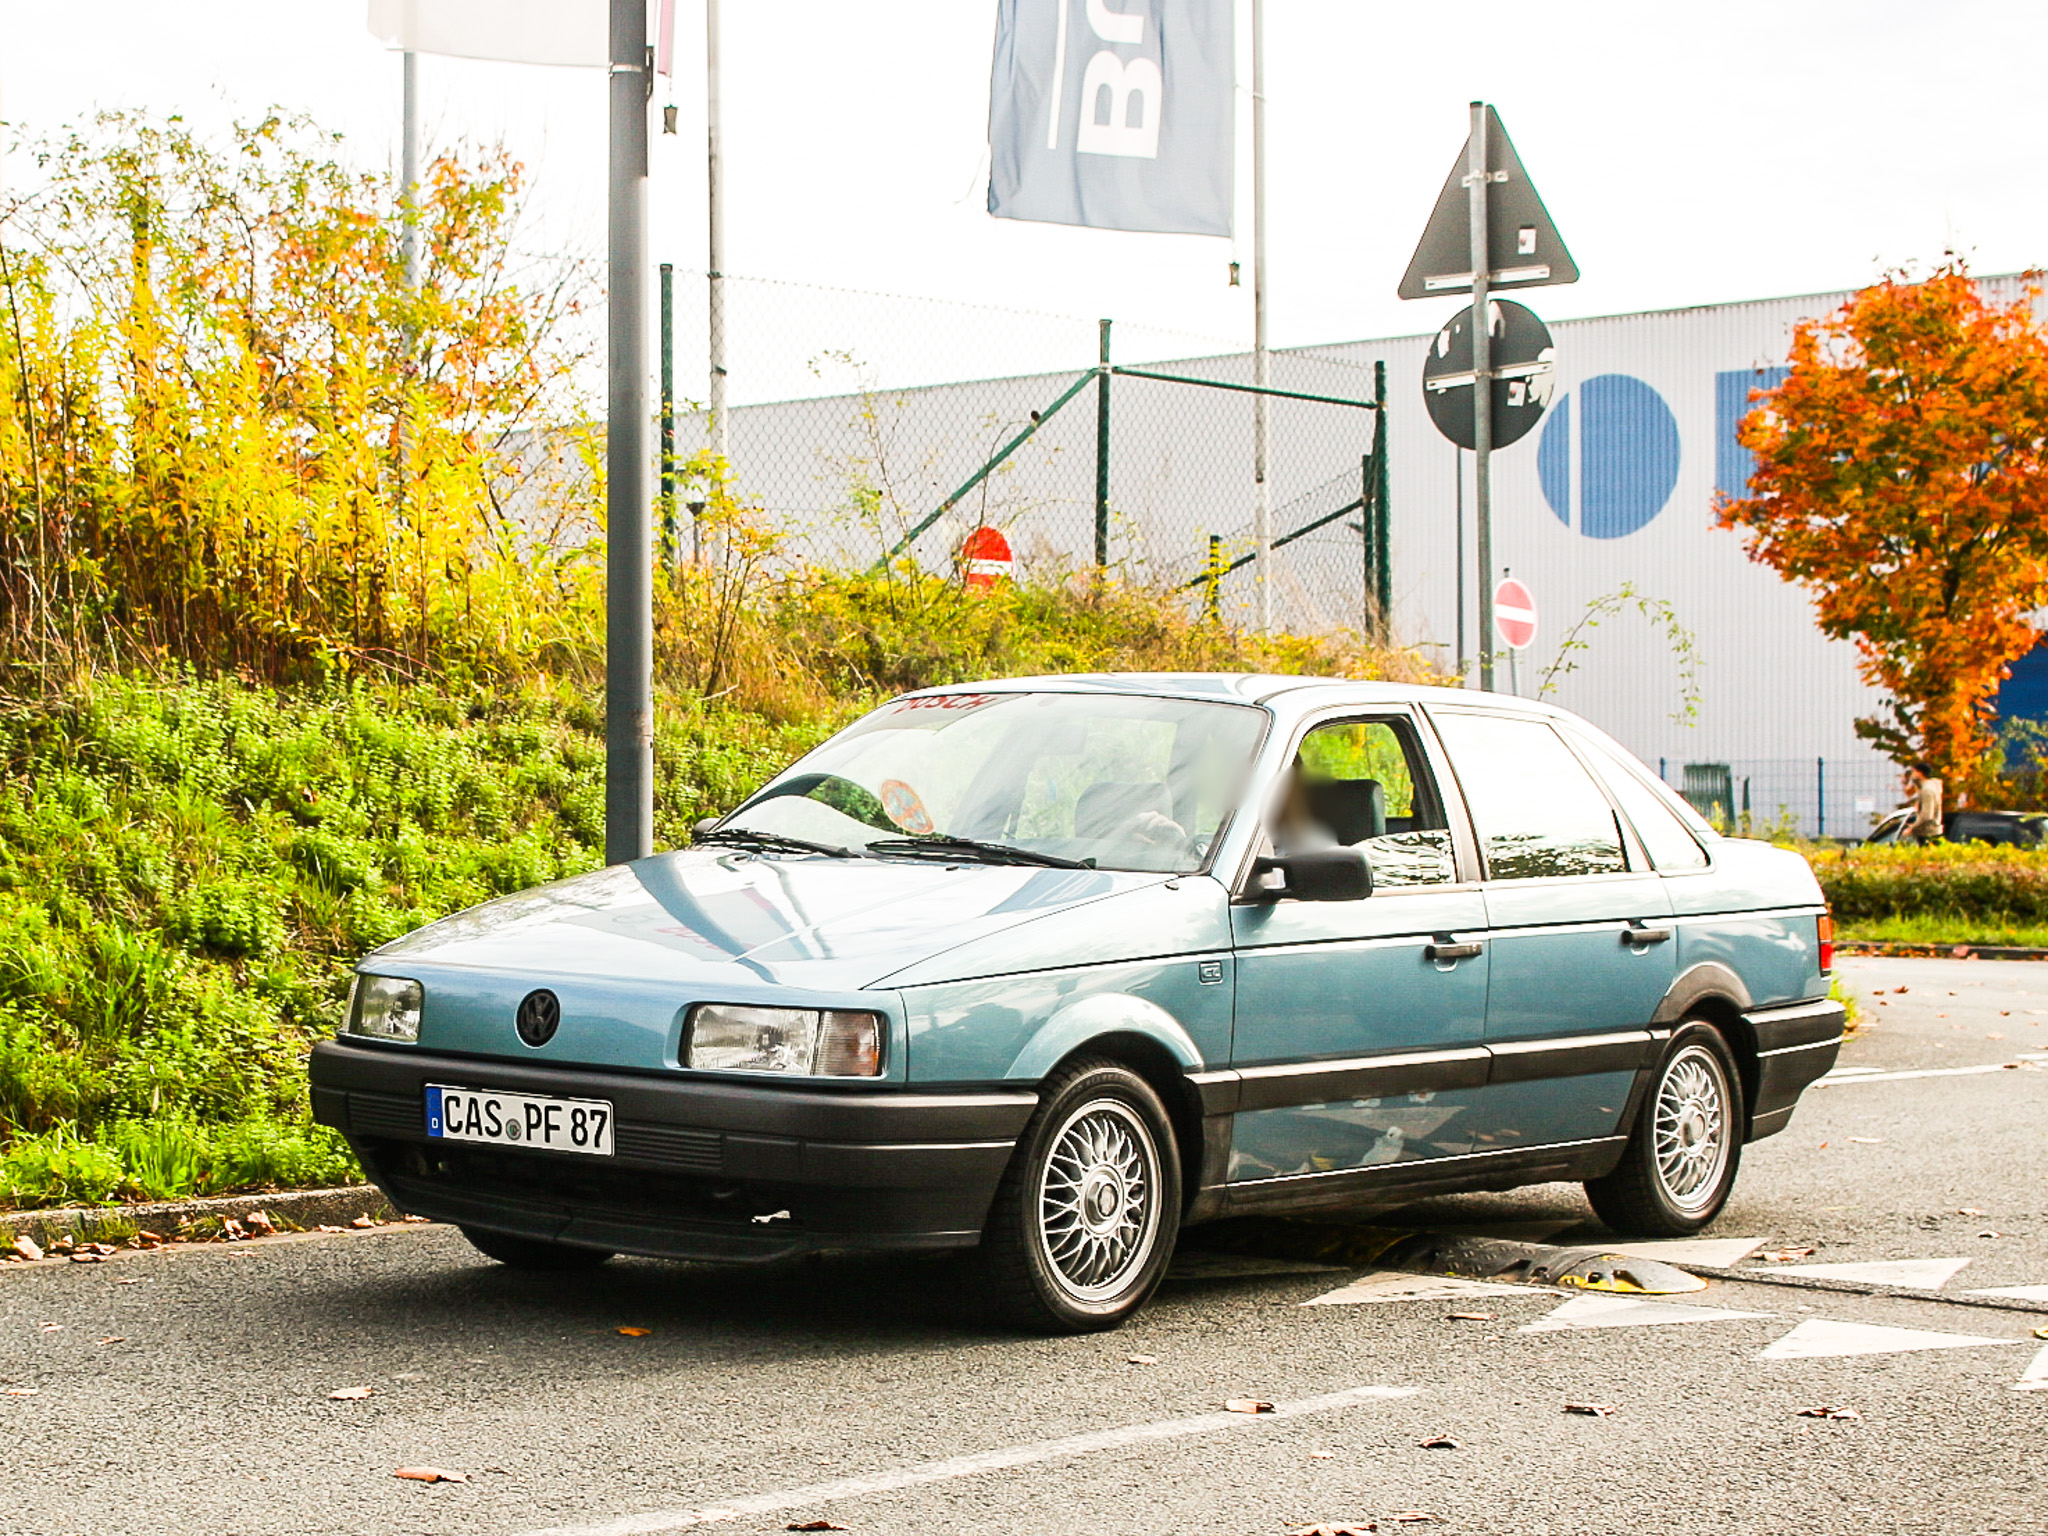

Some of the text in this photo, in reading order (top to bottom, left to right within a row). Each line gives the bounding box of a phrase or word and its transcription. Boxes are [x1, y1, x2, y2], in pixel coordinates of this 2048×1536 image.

[431, 1117, 439, 1129] D
[444, 1095, 608, 1148] CAS PF 87
